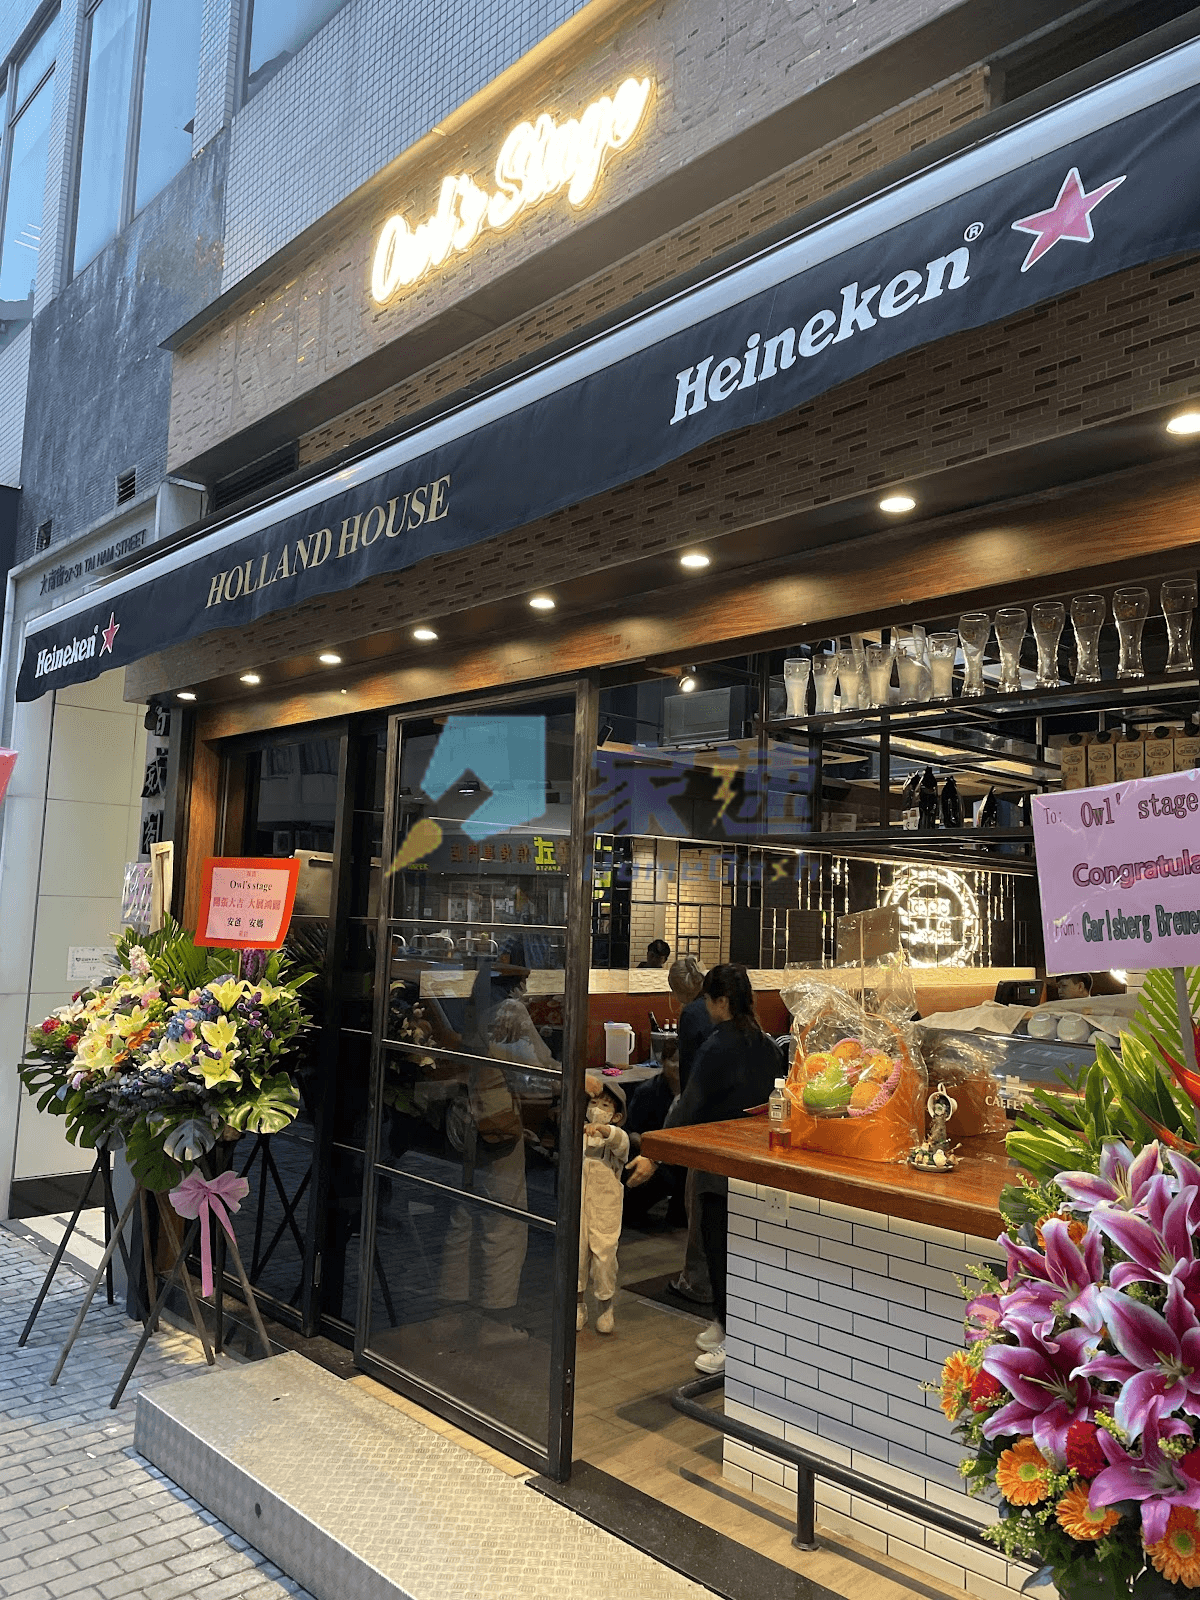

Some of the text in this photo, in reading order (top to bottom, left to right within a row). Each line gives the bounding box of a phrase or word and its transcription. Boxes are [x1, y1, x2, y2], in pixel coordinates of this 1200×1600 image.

[669, 246, 971, 426] Heineken
[84, 555, 96, 573] TAI
[97, 545, 115, 568] NAM
[115, 529, 147, 558] STREET
[205, 474, 451, 609] HOLLAND HOUSE
[34, 634, 96, 679] Heineken
[1138, 792, 1199, 820] stage
[229, 880, 273, 893] Owl's stage
[1072, 849, 1200, 889] Congratula
[1081, 908, 1153, 944] Carlsberg
